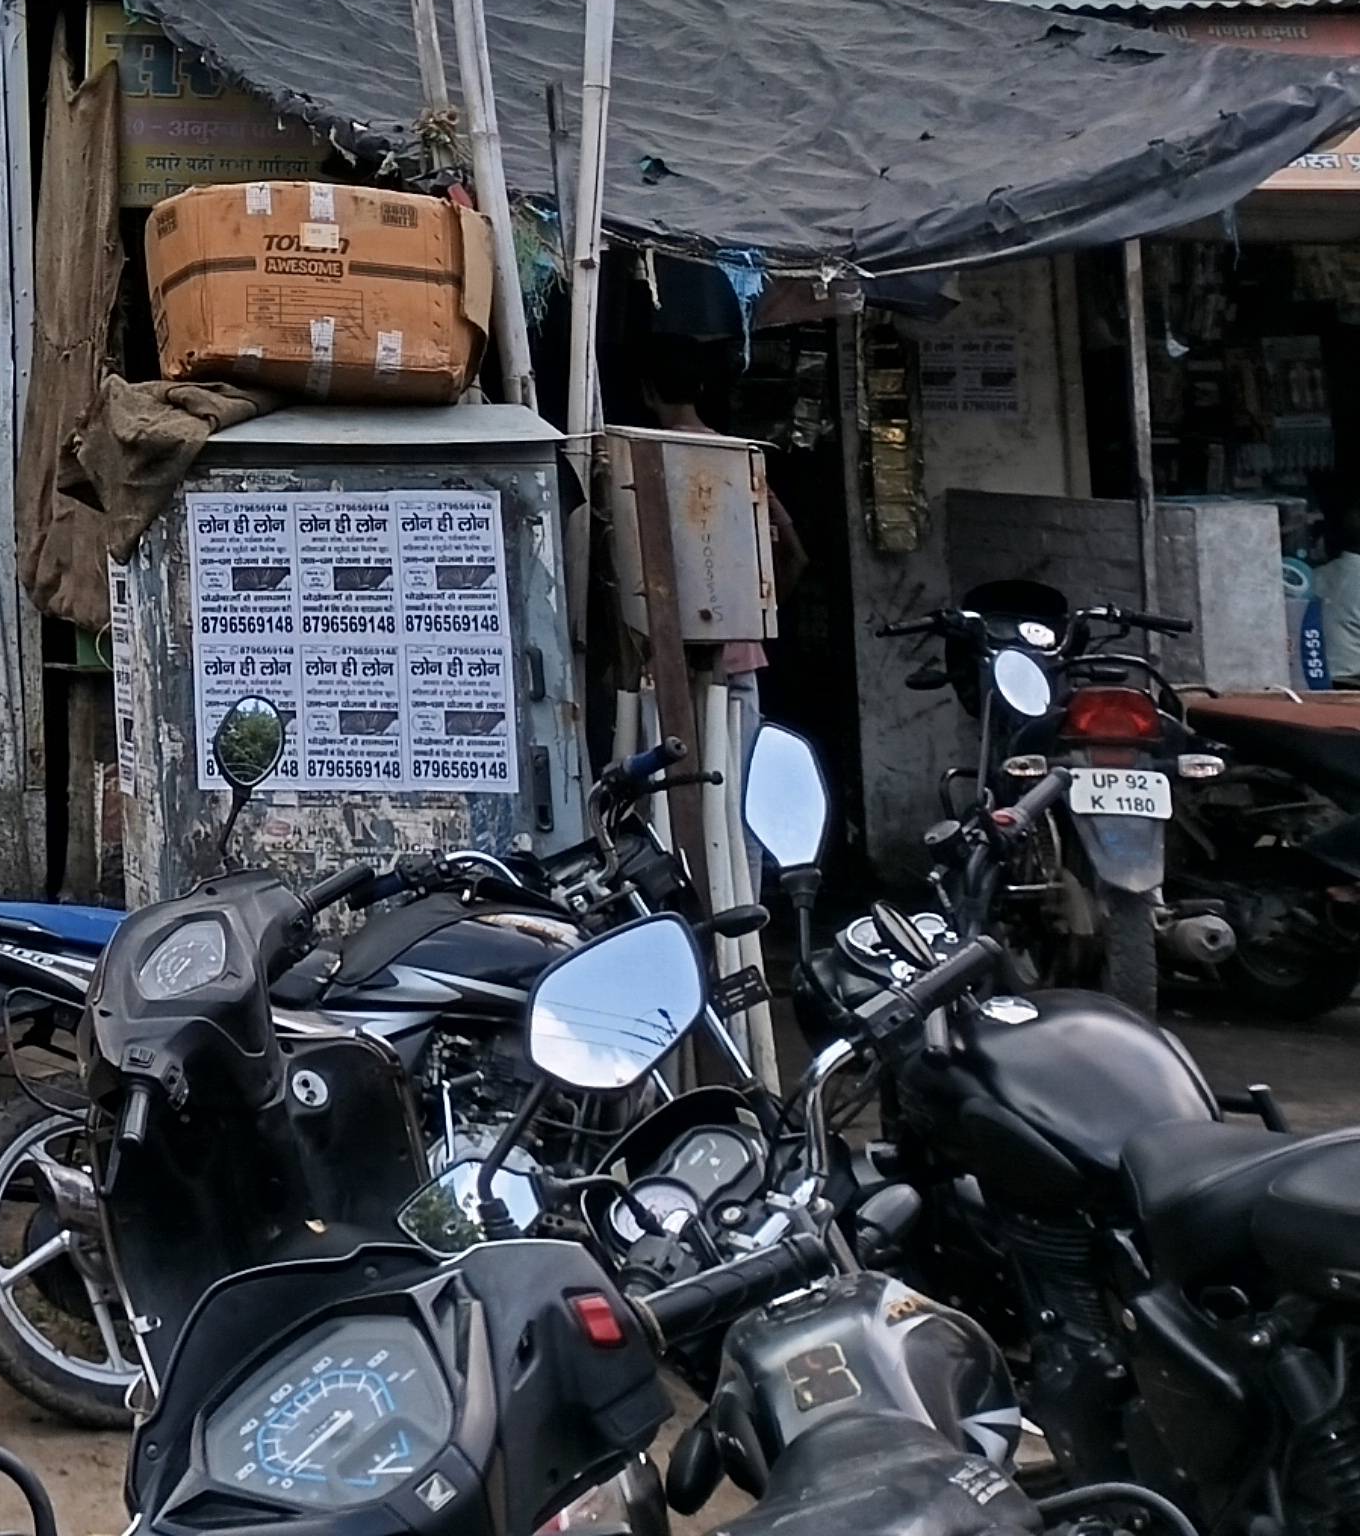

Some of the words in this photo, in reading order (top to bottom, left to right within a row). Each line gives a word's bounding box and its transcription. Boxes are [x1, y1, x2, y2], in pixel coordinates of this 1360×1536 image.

[266, 257, 343, 277] AWESOME
[198, 514, 229, 534] लोन
[233, 514, 249, 535] ही
[253, 514, 286, 533] लोन
[299, 513, 330, 533] लोन
[335, 513, 351, 535] ही
[355, 514, 388, 533] लोन
[401, 512, 433, 532] लोन
[436, 512, 453, 533] ही
[457, 512, 491, 531] लोन
[200, 616, 294, 634] 8796569148
[301, 615, 396, 634] 8796569148
[404, 614, 500, 633] 8796569148
[204, 655, 235, 676] लोन
[239, 656, 255, 677] ही
[259, 656, 292, 676] लोन
[305, 655, 337, 677] लोन
[341, 656, 357, 678] ही
[361, 657, 395, 677] लोन
[410, 655, 442, 677] लोन
[446, 656, 463, 678] ही
[467, 657, 501, 677] लोन
[306, 759, 402, 780] 8796569148
[411, 759, 508, 781] 8796569148
[1092, 774, 1119, 789] UP
[1125, 775, 1148, 790] 92
[1091, 795, 1104, 810] K
[1116, 797, 1155, 812] 1180
